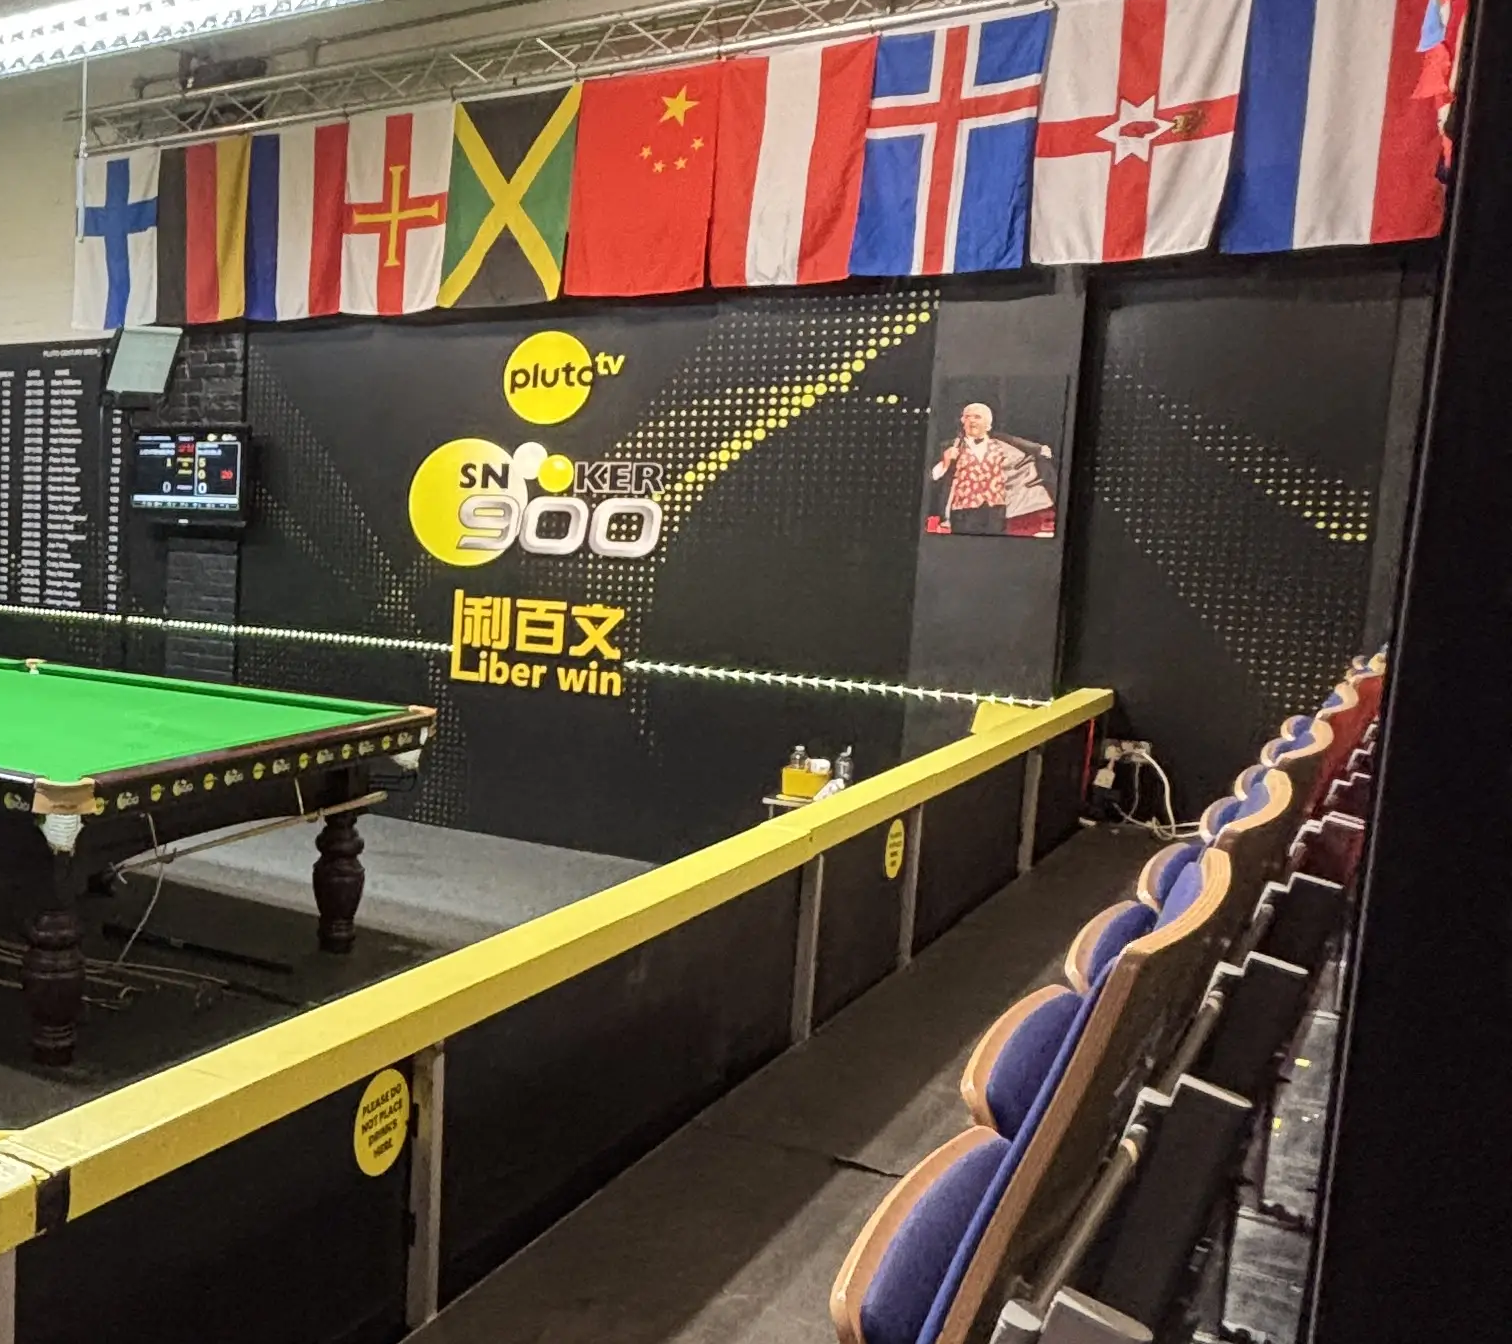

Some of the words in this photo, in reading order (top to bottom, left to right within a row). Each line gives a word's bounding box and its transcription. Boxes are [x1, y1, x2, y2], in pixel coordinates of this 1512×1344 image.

[456, 494, 663, 558] 900
[450, 588, 548, 689] Liber
[557, 660, 622, 697] win
[462, 595, 625, 660] 利百文
[361, 1114, 379, 1135] NOT
[379, 1098, 403, 1122] PLACE
[363, 1090, 390, 1117] PLEASE
[390, 1083, 402, 1097] DO
